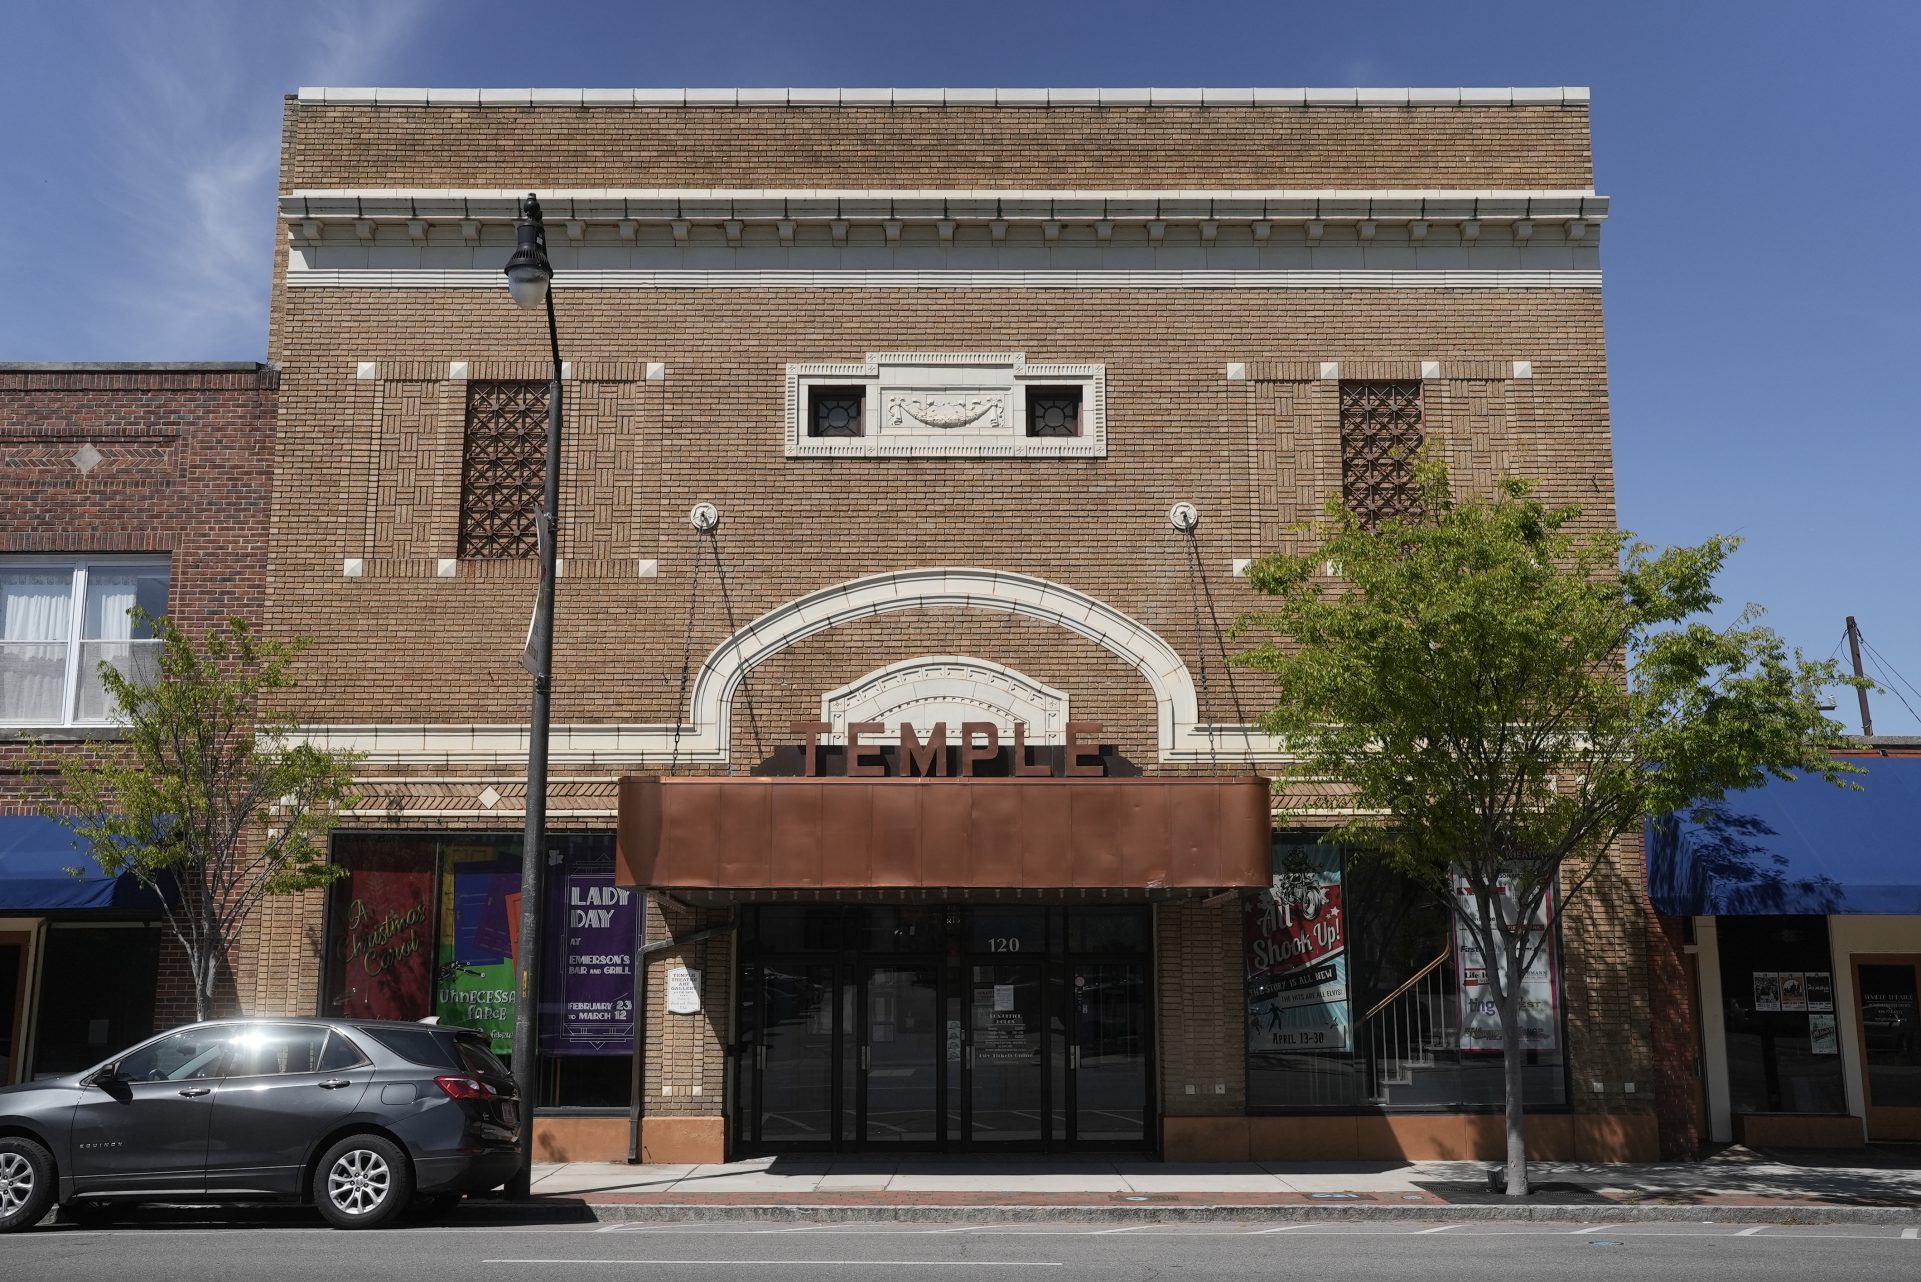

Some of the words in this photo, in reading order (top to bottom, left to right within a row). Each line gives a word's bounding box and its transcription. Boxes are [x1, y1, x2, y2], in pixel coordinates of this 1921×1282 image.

[790, 721, 1104, 777] TEMPLE
[571, 886, 631, 906] LADY
[570, 909, 615, 928] DAY
[1257, 903, 1293, 937] All
[336, 903, 426, 964] Christmas
[570, 937, 582, 946] AT
[363, 928, 419, 977] Carol
[988, 937, 1020, 953] 120
[1252, 928, 1313, 970] Shook
[1313, 918, 1341, 950] Up!
[569, 954, 631, 965] EMERSON'S
[568, 966, 588, 975] BAR
[603, 966, 632, 975] GRILL
[1265, 981, 1286, 994] STORY
[1289, 978, 1297, 987] IS
[1299, 975, 1314, 985] ALL
[1315, 968, 1333, 981] NEW
[439, 989, 516, 1004] UNNECESSA
[567, 1002, 613, 1010] FEBRUARY
[616, 1000, 633, 1010] 23
[578, 1012, 611, 1020] MARCH
[614, 1010, 627, 1020] 12
[1300, 1031, 1324, 1044] 13-30
